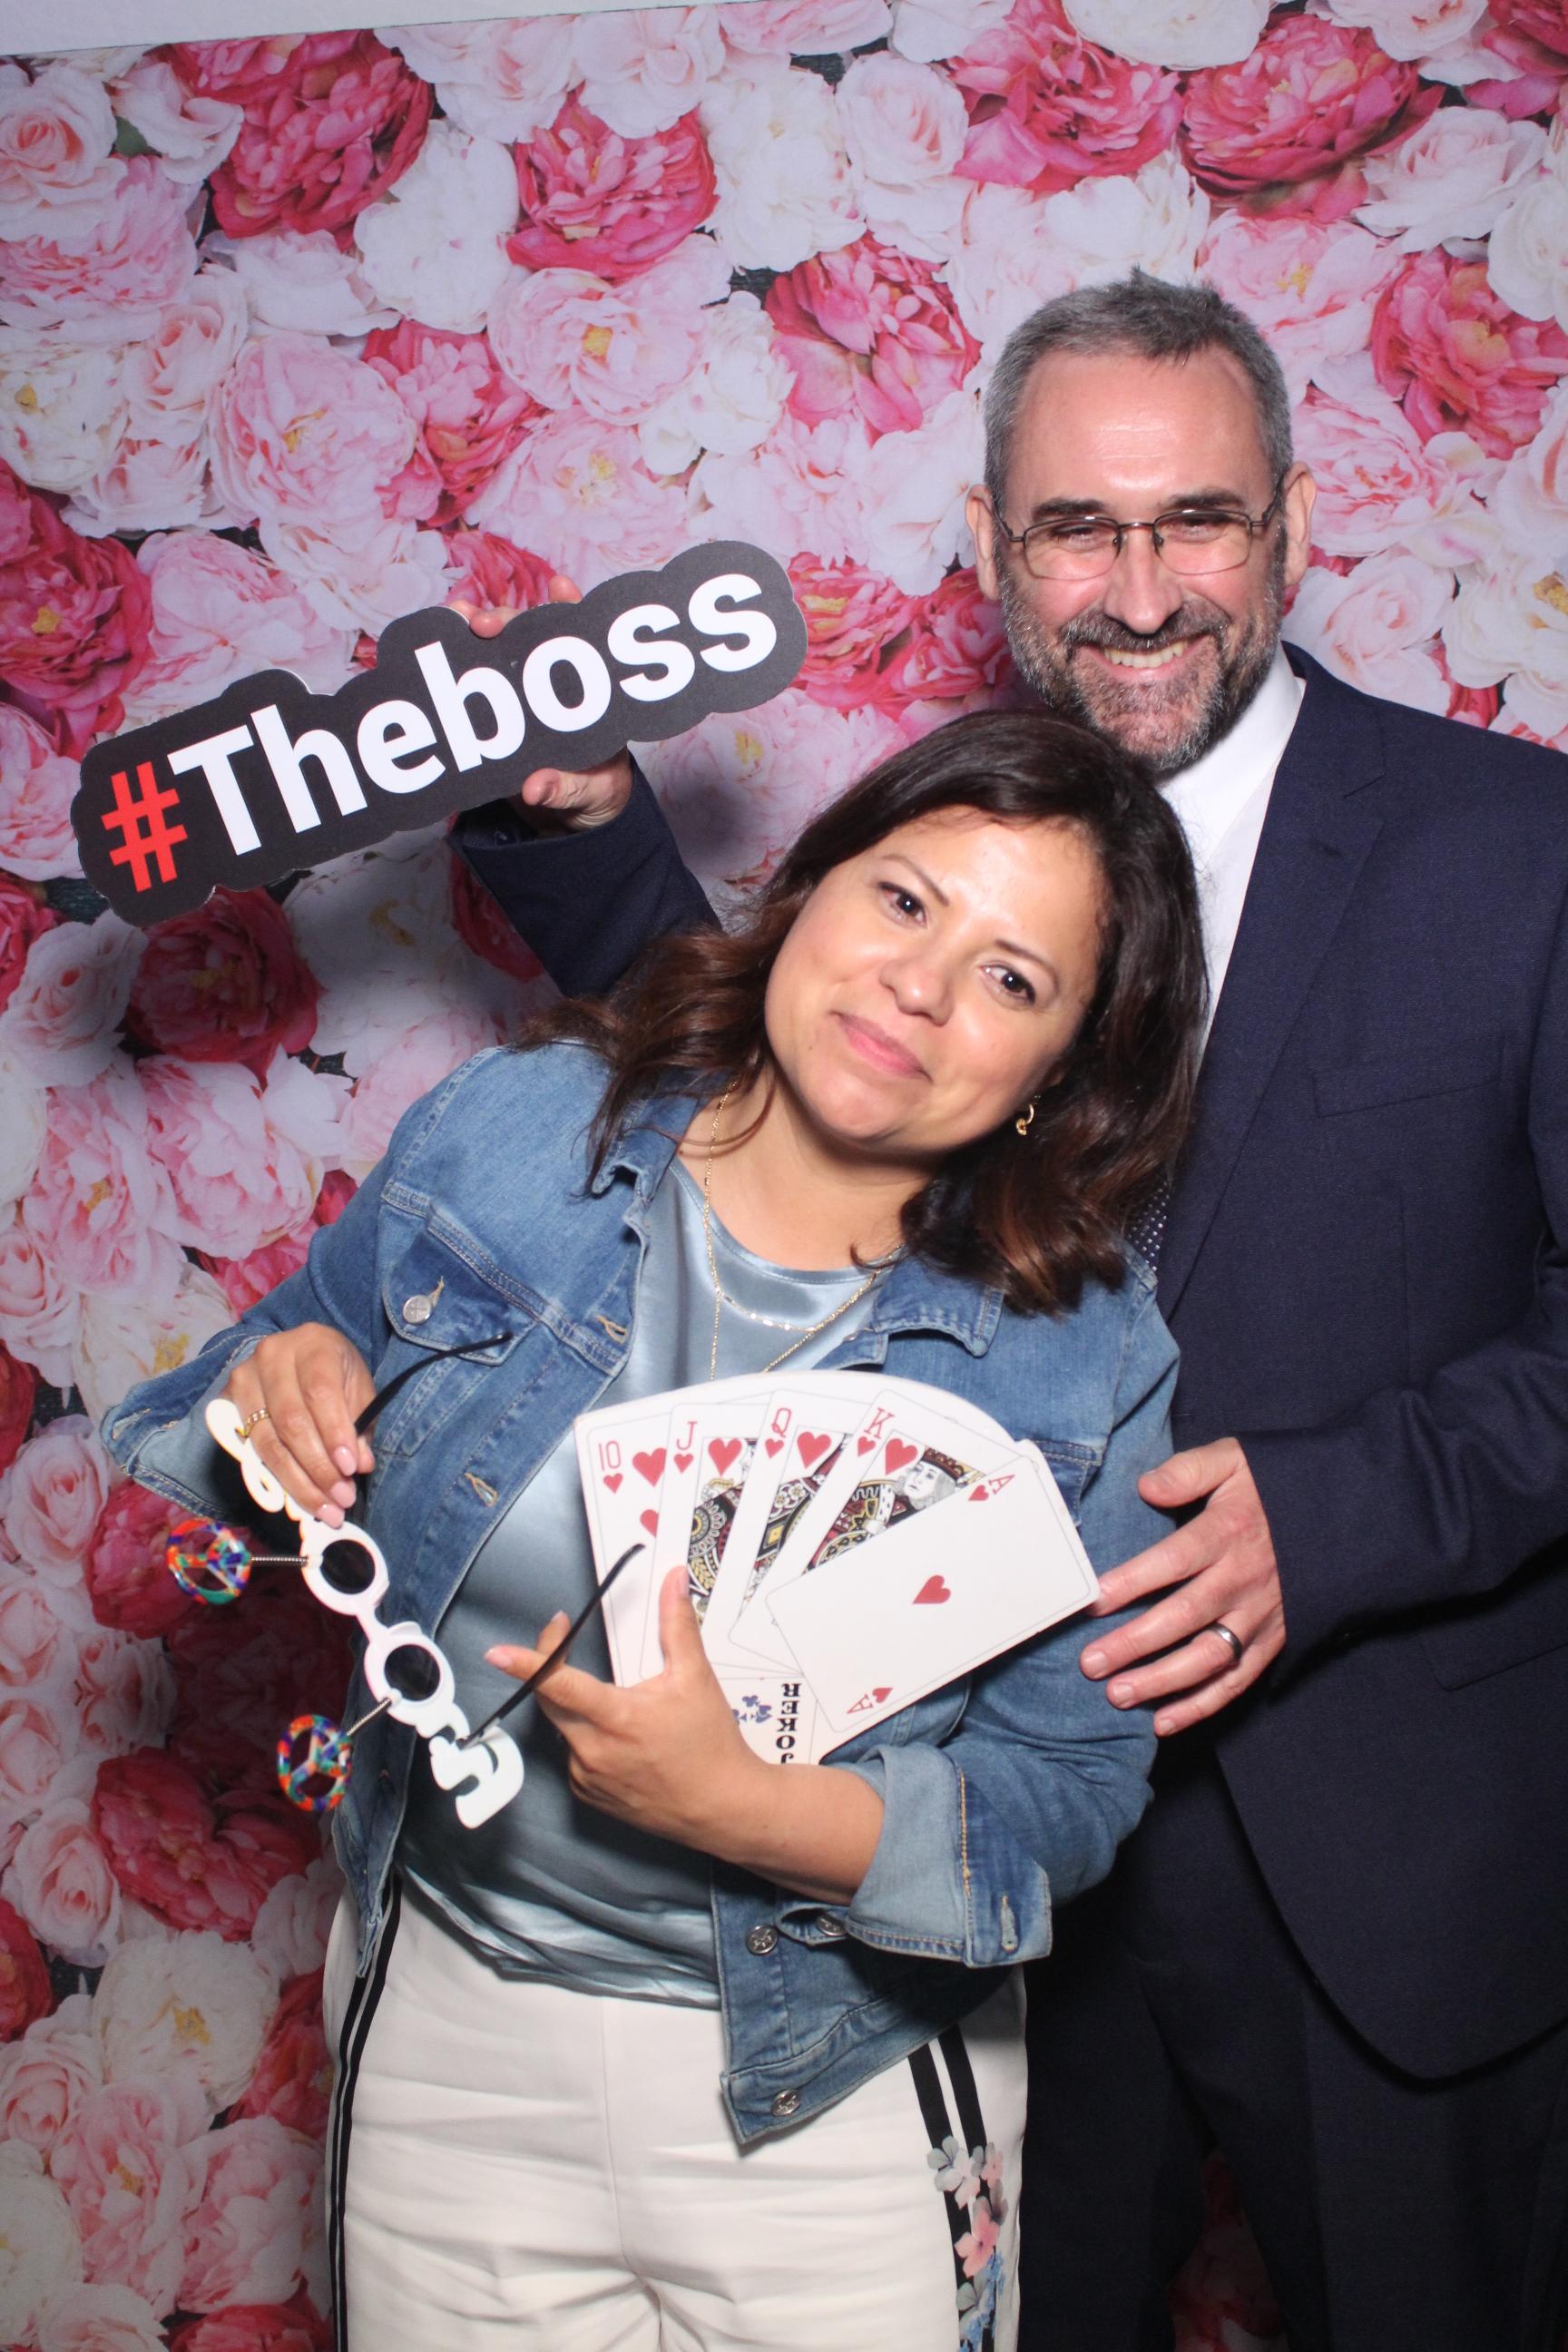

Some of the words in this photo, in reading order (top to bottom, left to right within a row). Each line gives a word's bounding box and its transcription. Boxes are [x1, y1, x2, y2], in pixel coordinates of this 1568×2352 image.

[101, 573, 778, 893] #Theboss
[676, 1421, 698, 1451] J
[771, 1407, 792, 1438] Q
[863, 1407, 895, 1439] K
[598, 1440, 622, 1472] 10
[987, 1474, 1016, 1495] A
[845, 1692, 874, 1715] A
[775, 1682, 802, 1764] JOKER
